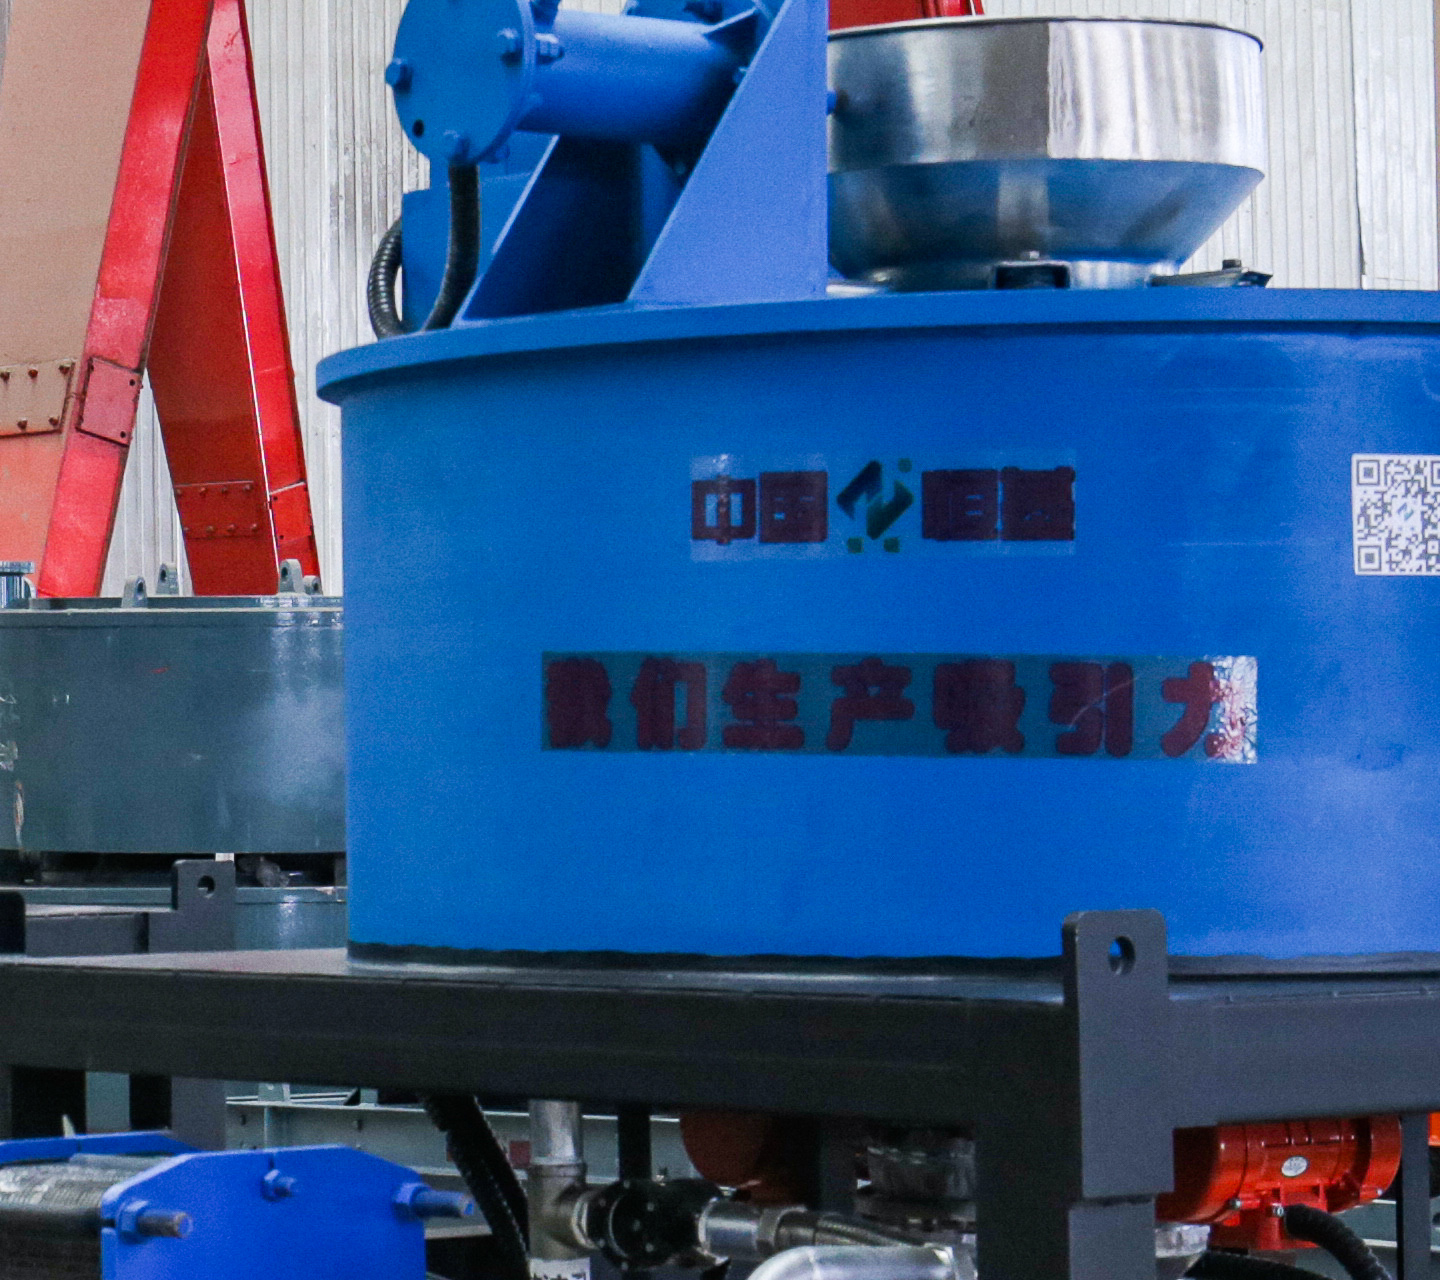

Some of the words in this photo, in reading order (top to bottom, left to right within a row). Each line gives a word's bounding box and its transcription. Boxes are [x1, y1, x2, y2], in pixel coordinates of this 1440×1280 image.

[546, 656, 1244, 757] 我们生产吸引力
